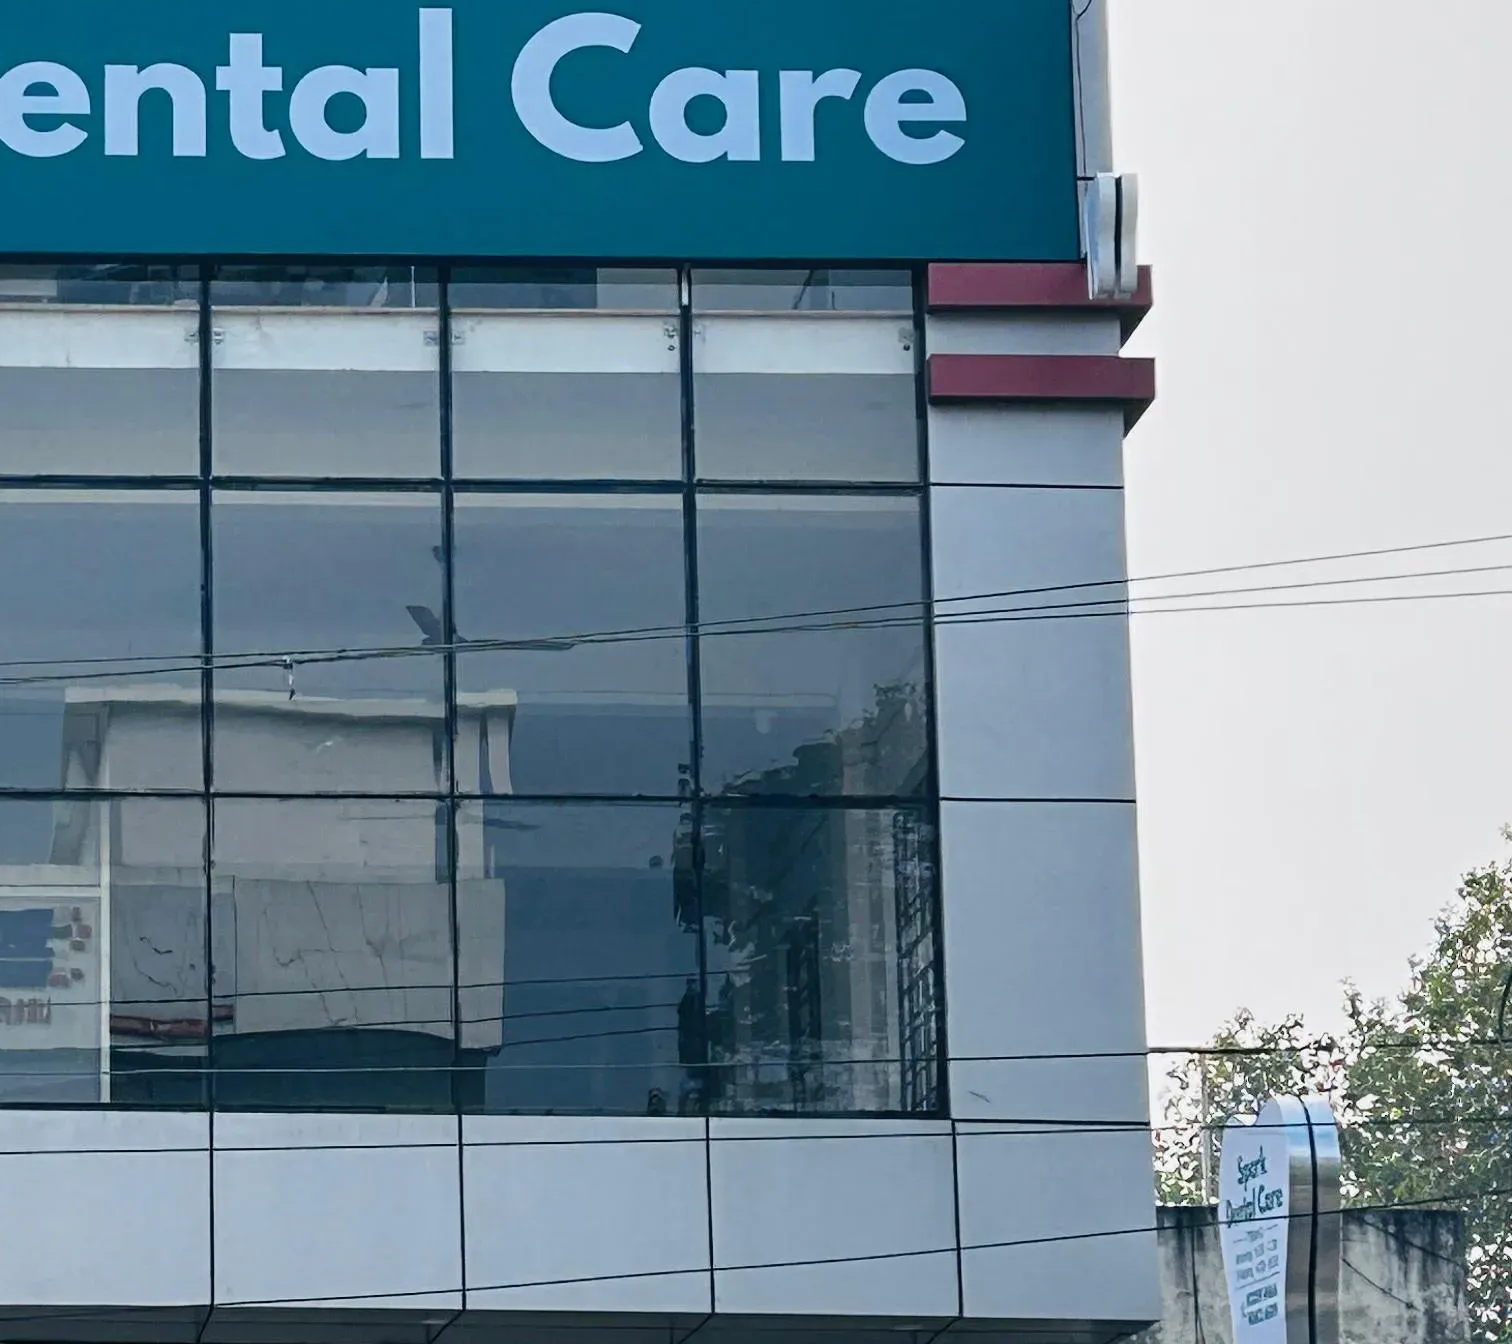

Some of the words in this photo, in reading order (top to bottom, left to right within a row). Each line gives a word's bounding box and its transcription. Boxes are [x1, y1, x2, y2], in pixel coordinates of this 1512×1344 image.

[510, 11, 968, 168] Care
[1237, 1145, 1268, 1192] Spark
[1257, 1184, 1283, 1214] Care
